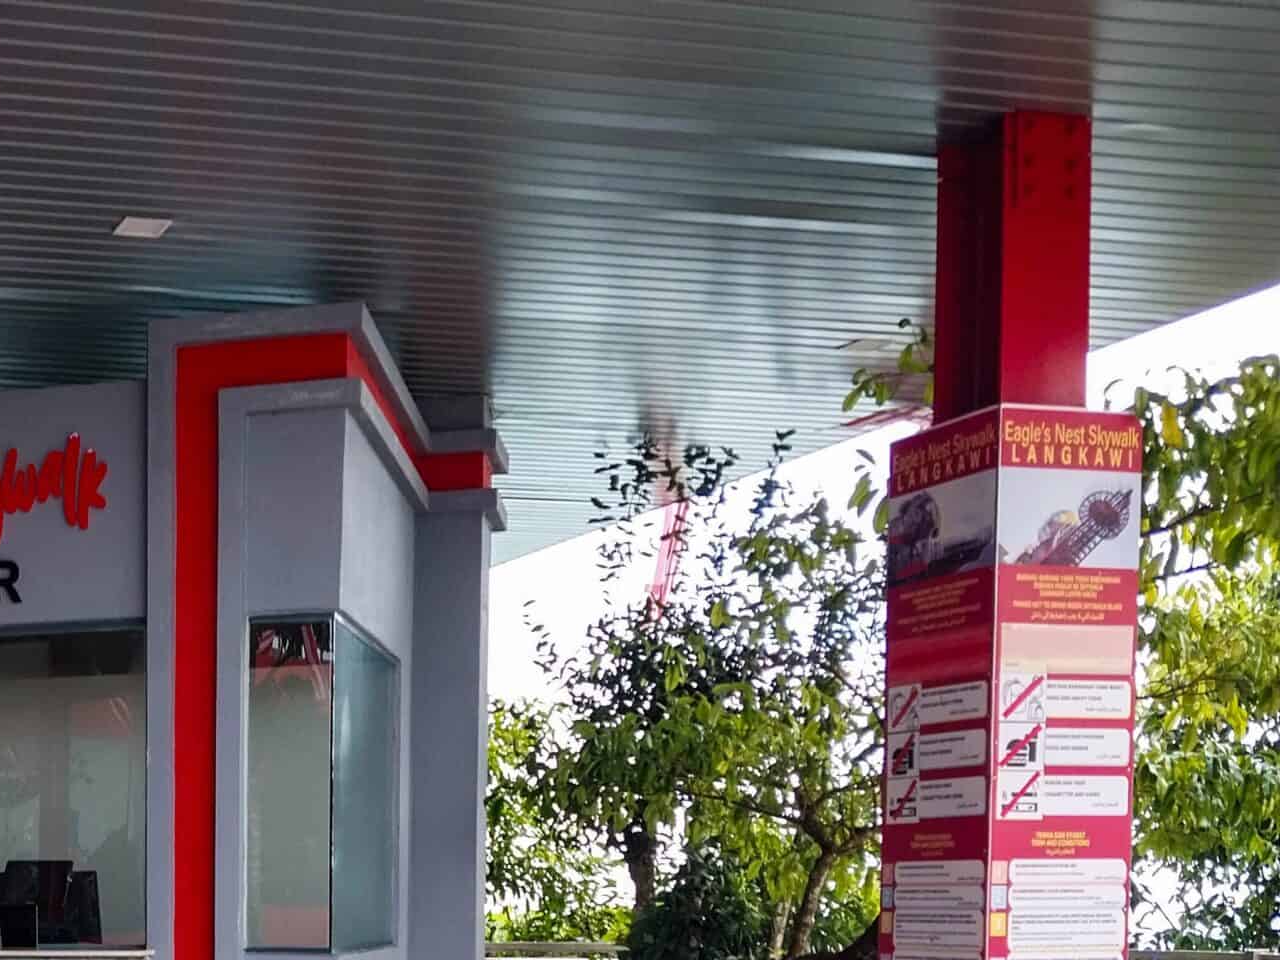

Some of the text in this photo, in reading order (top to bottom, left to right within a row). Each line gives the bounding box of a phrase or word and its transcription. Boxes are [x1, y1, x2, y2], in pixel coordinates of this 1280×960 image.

[1004, 420, 1140, 451] Eagle's Nest Skywalk
[897, 447, 990, 492] LANGKAWI
[1011, 443, 1133, 469] LANGKAWI
